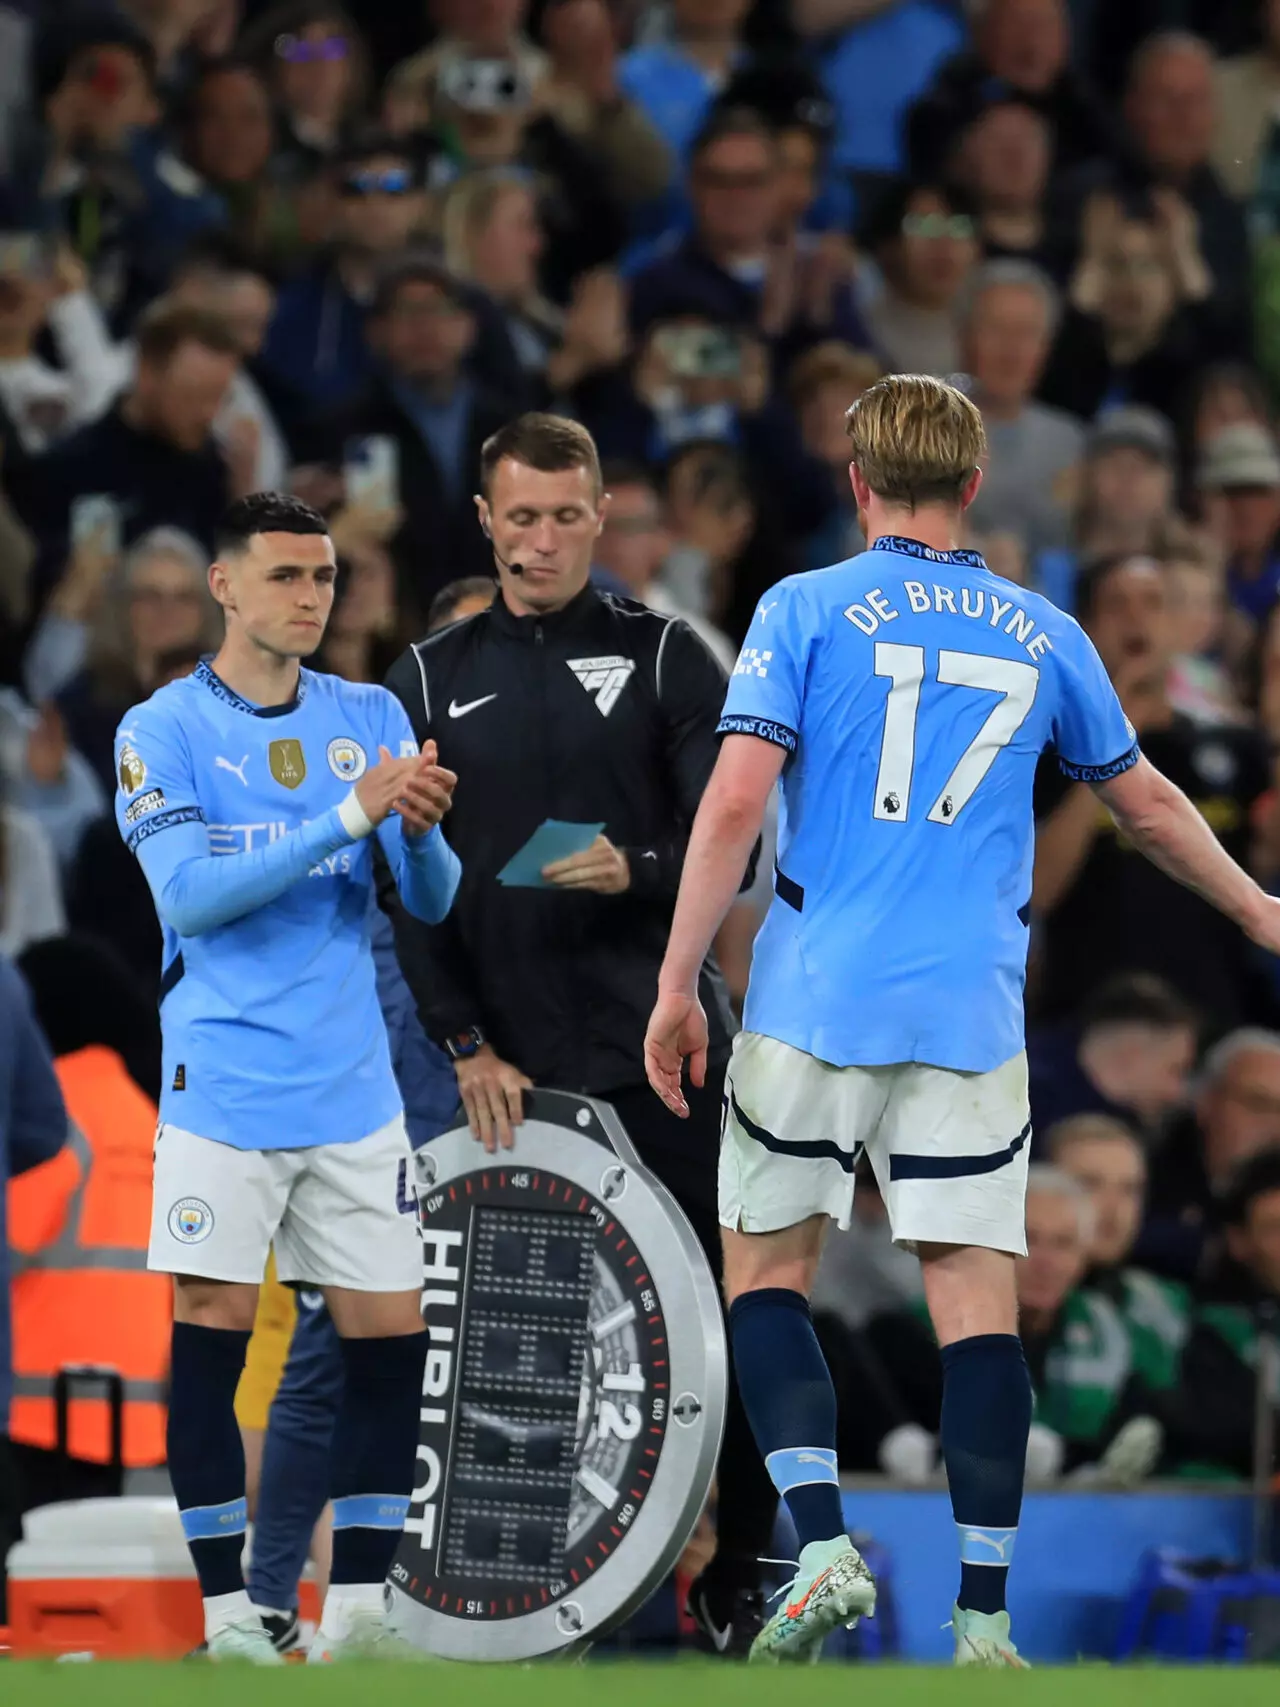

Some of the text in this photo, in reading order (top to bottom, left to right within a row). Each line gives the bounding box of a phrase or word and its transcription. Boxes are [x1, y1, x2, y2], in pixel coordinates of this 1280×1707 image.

[924, 546, 949, 562] CITY
[843, 580, 1054, 662] DE BRUYNE
[873, 641, 1040, 826] 17
[600, 1362, 646, 1440] 12
[390, 1562, 410, 1583] 20
